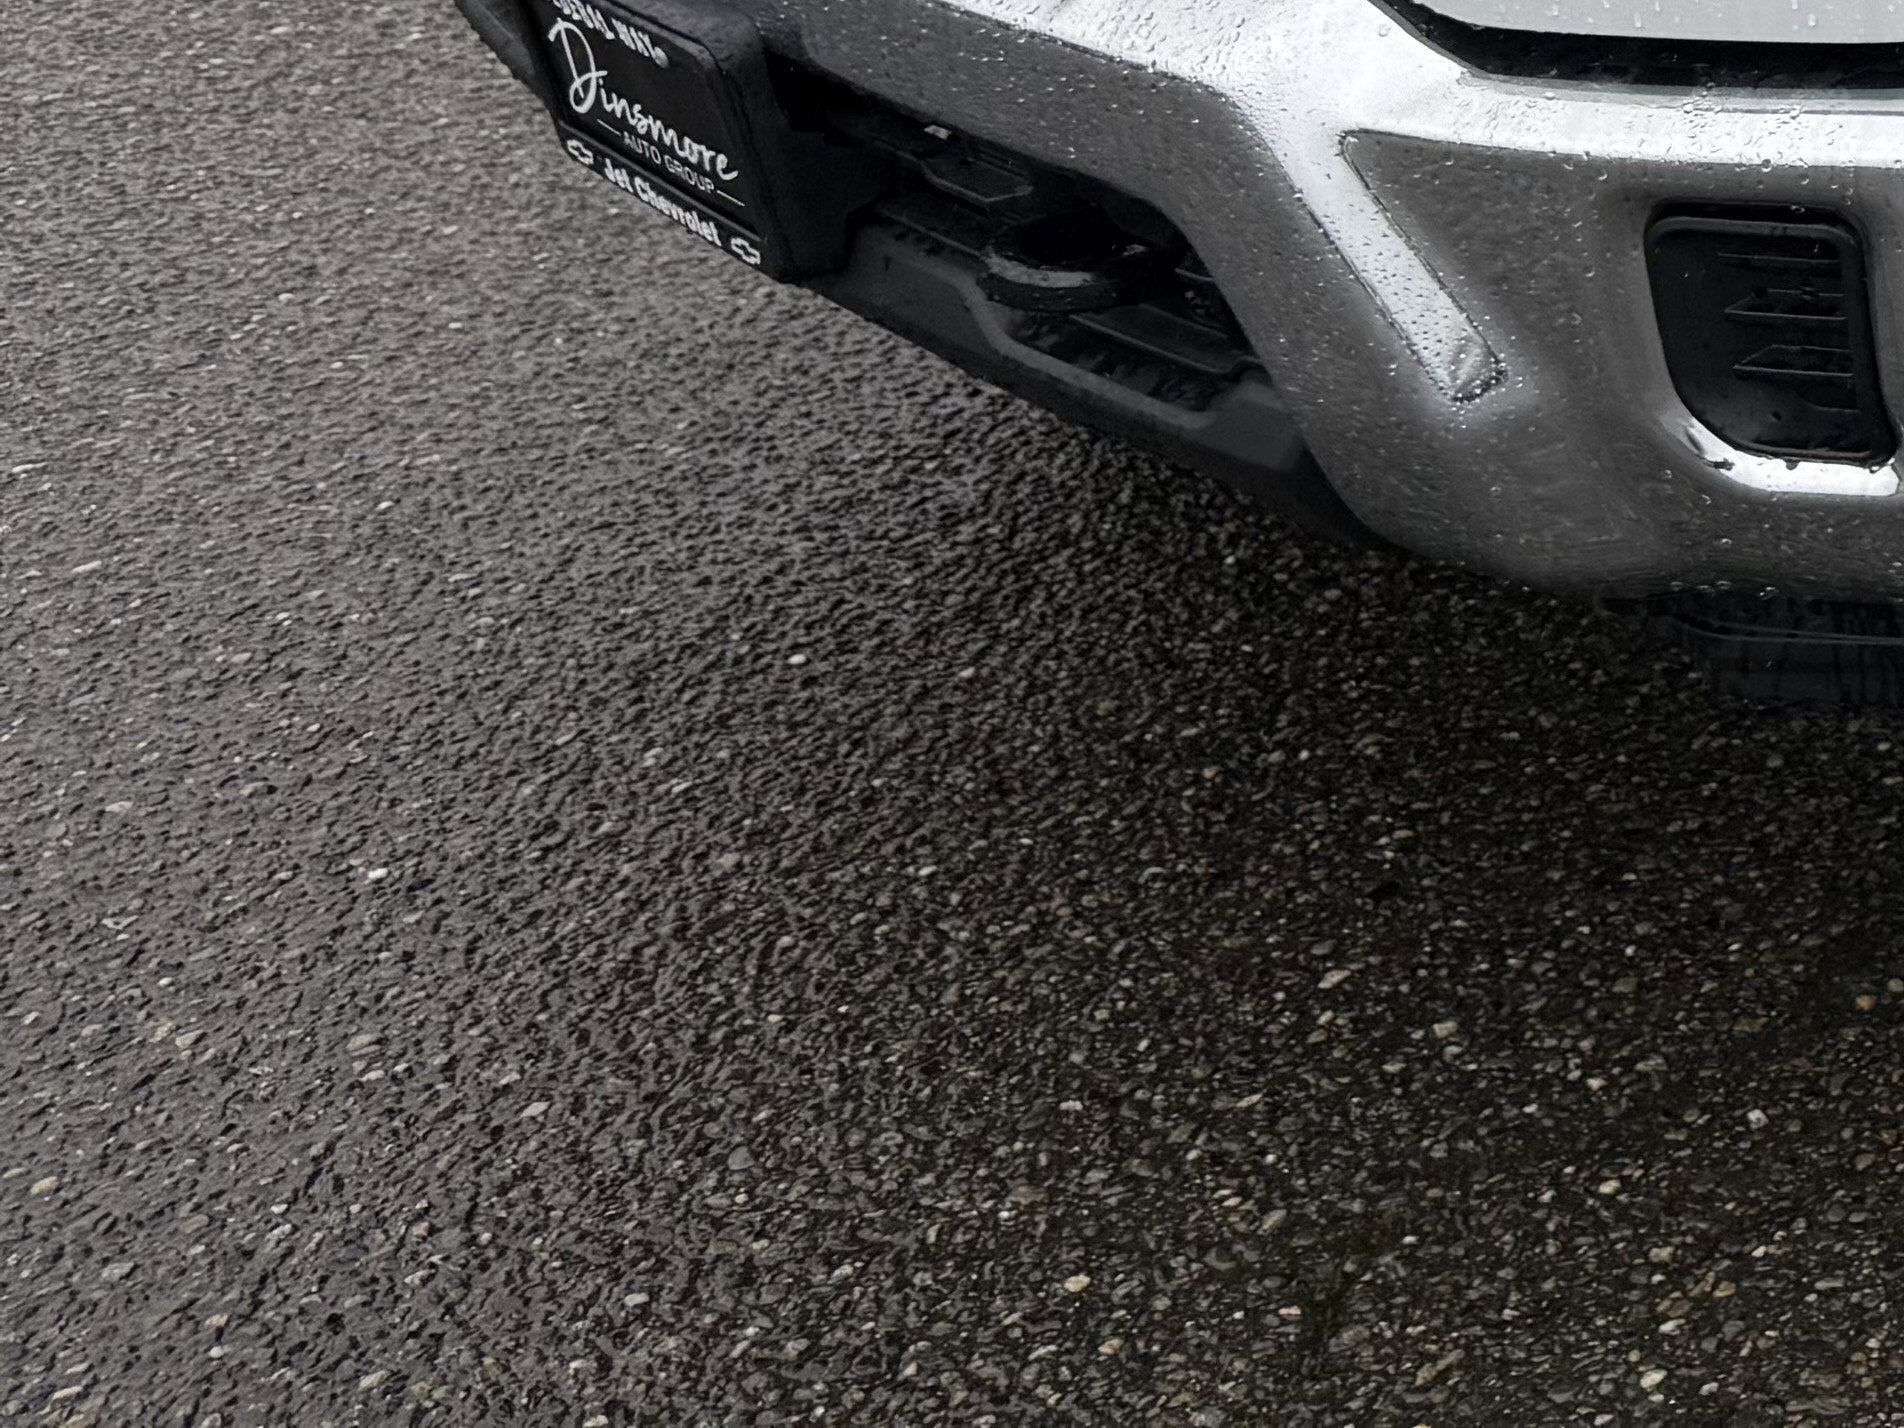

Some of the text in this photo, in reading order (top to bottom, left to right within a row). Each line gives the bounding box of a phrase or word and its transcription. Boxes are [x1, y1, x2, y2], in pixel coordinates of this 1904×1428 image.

[547, 17, 739, 182] Dinsmore
[604, 157, 722, 247] Jet Chevrolet
[623, 131, 714, 194] AUTO GROUP
